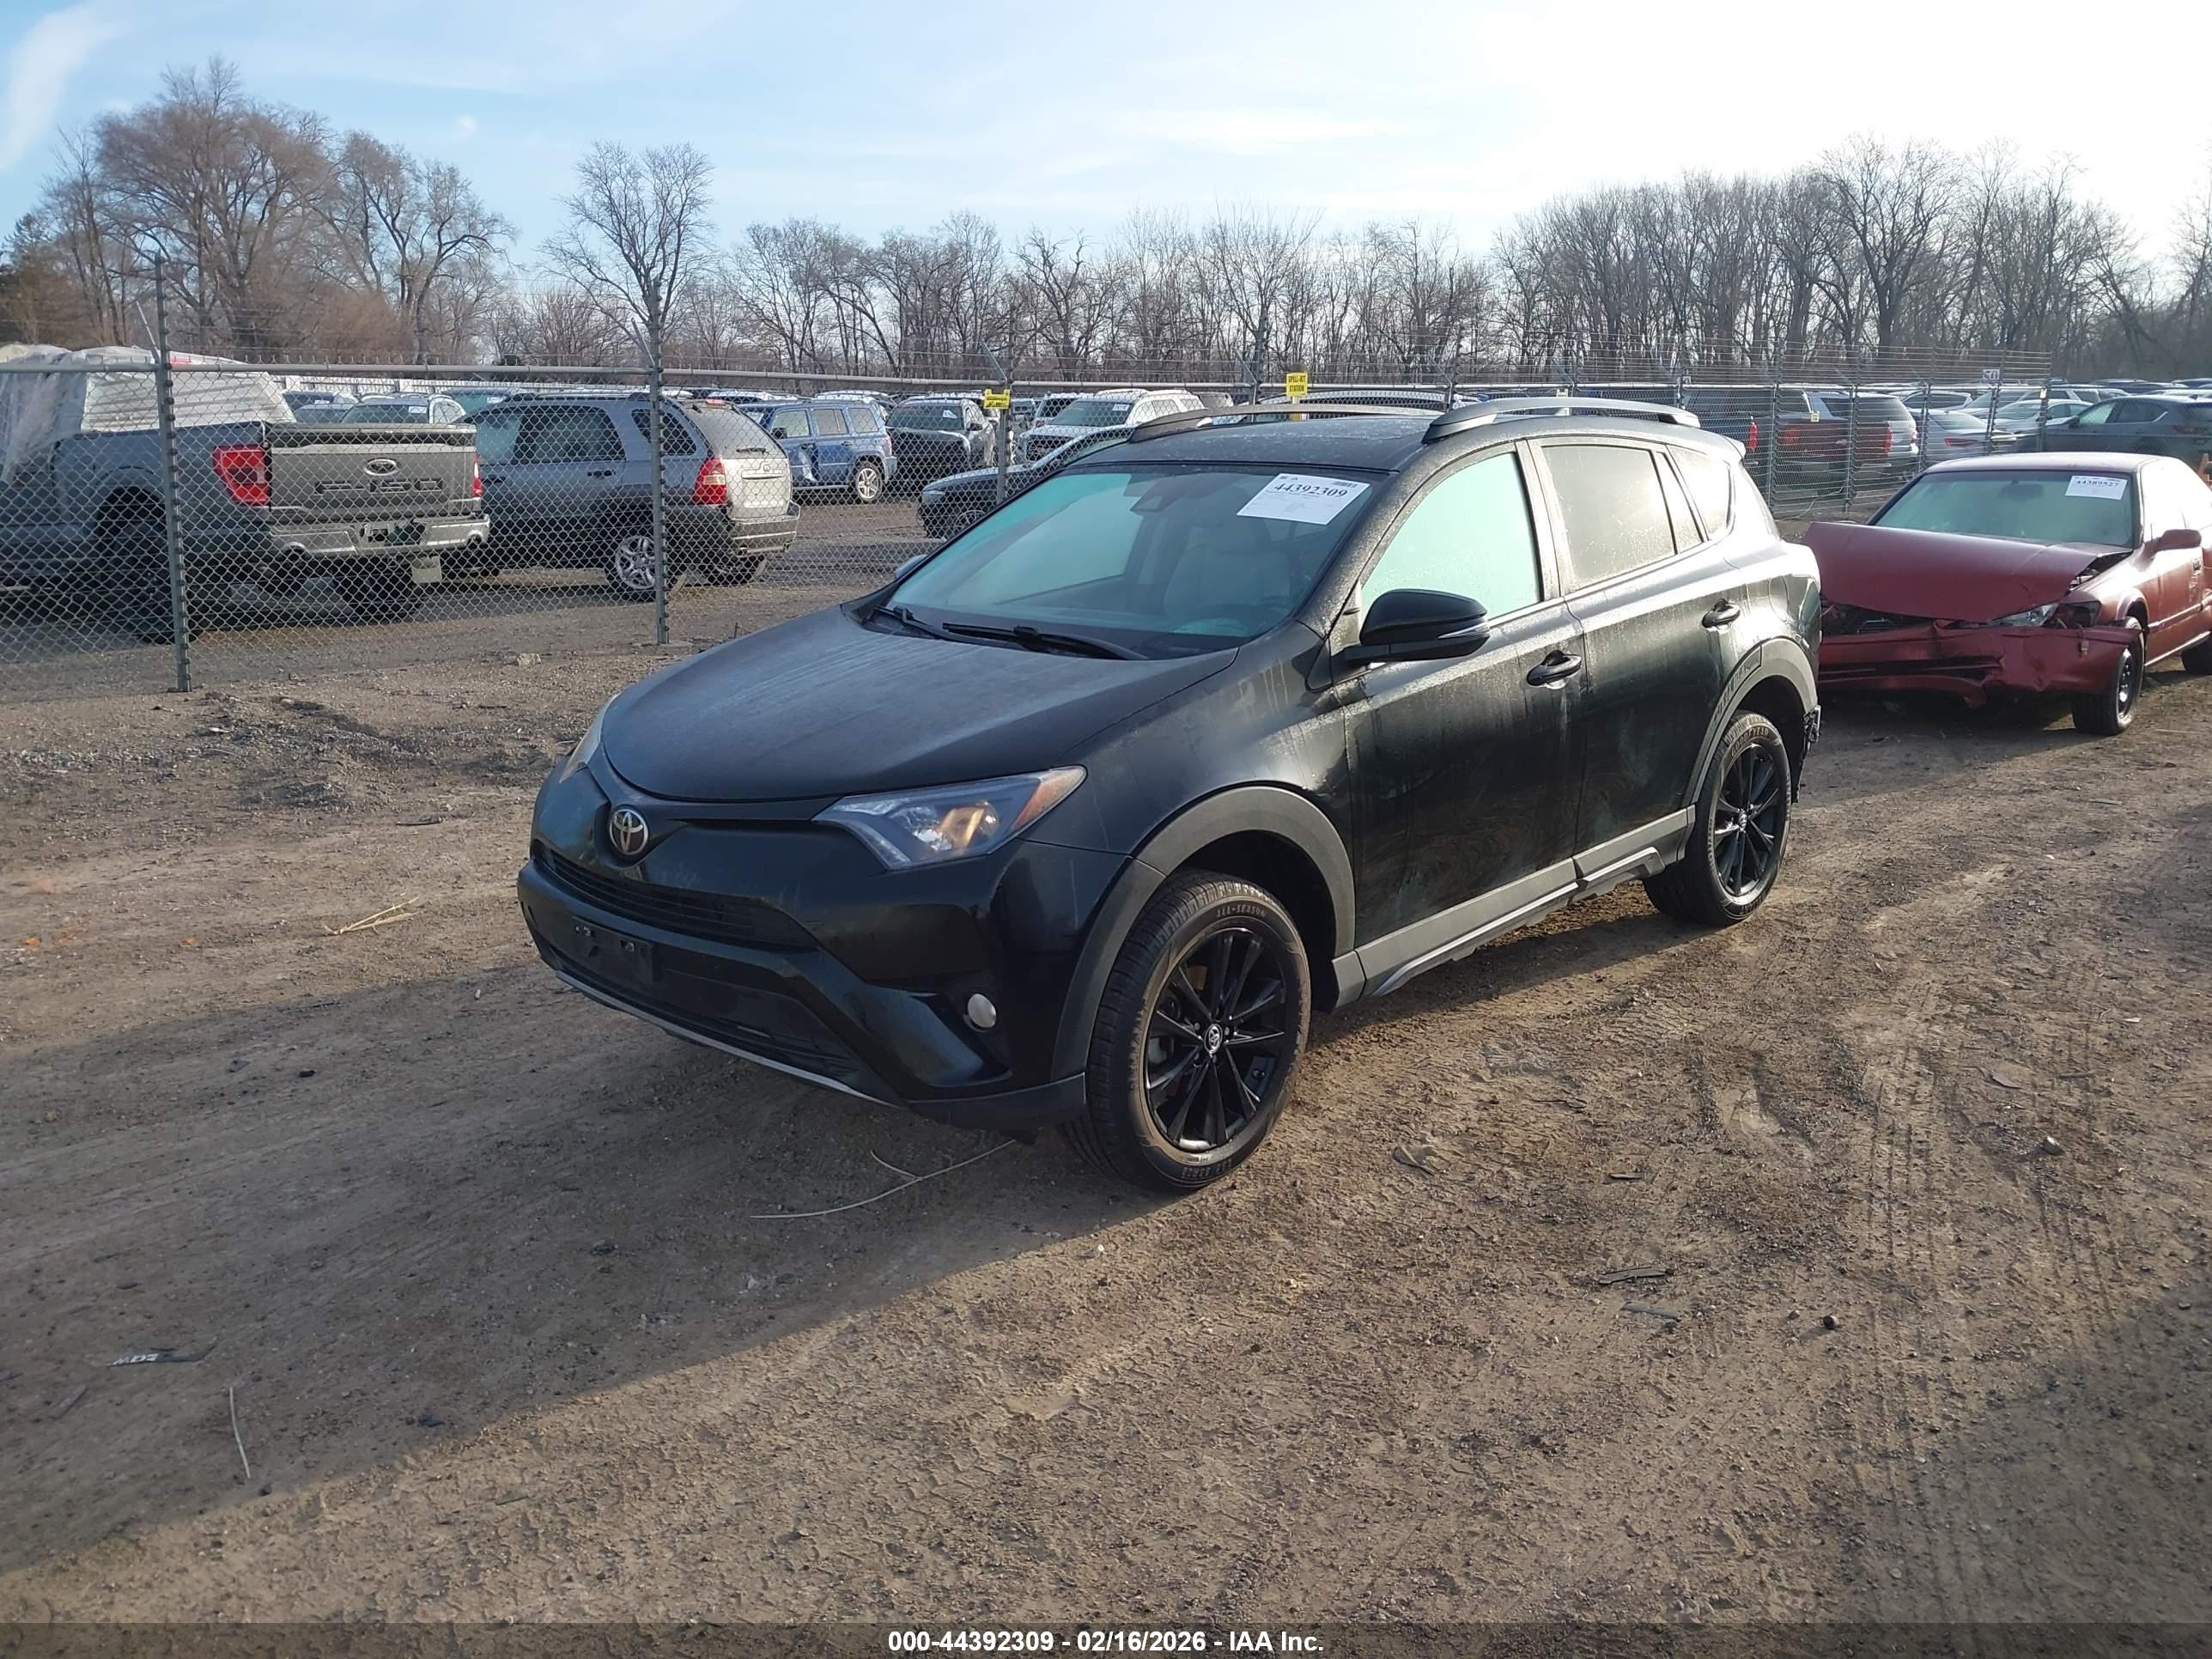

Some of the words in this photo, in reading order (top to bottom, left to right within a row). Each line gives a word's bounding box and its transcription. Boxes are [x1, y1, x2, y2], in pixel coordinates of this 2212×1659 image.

[1273, 482, 1349, 498] 44392309
[1731, 726, 1770, 757] GOODYEAR
[1216, 904, 1267, 918] ALL-SEASON
